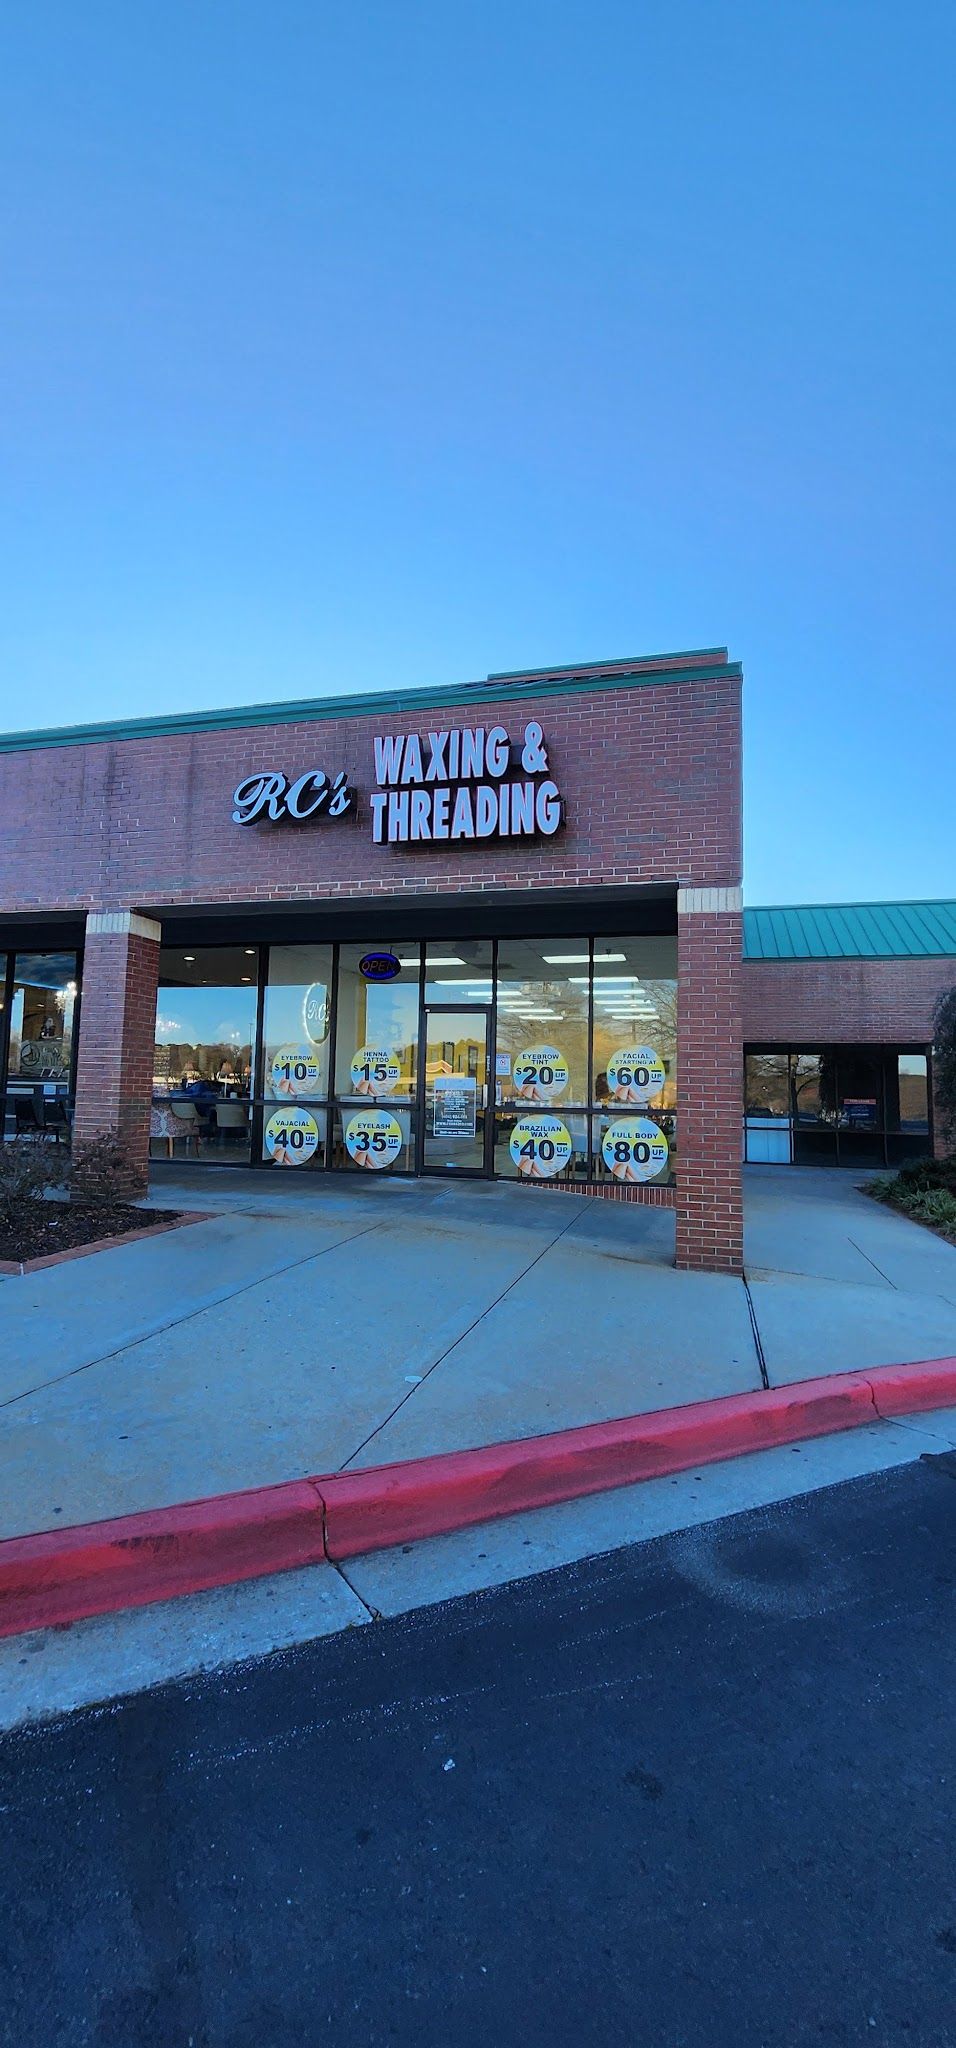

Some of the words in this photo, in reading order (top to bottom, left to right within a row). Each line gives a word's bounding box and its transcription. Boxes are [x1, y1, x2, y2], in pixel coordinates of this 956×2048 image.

[374, 726, 510, 785] WAXING
[521, 721, 549, 774] &
[232, 770, 351, 824] RC's
[370, 781, 560, 843] THREADING
[274, 1063, 307, 1081] $10
[353, 1063, 388, 1082] $15
[515, 1066, 554, 1085] $20
[609, 1067, 650, 1086] $60
[268, 1129, 304, 1149] $40
[349, 1131, 387, 1152] $35
[513, 1139, 555, 1160] $40
[606, 1141, 650, 1164] $80
